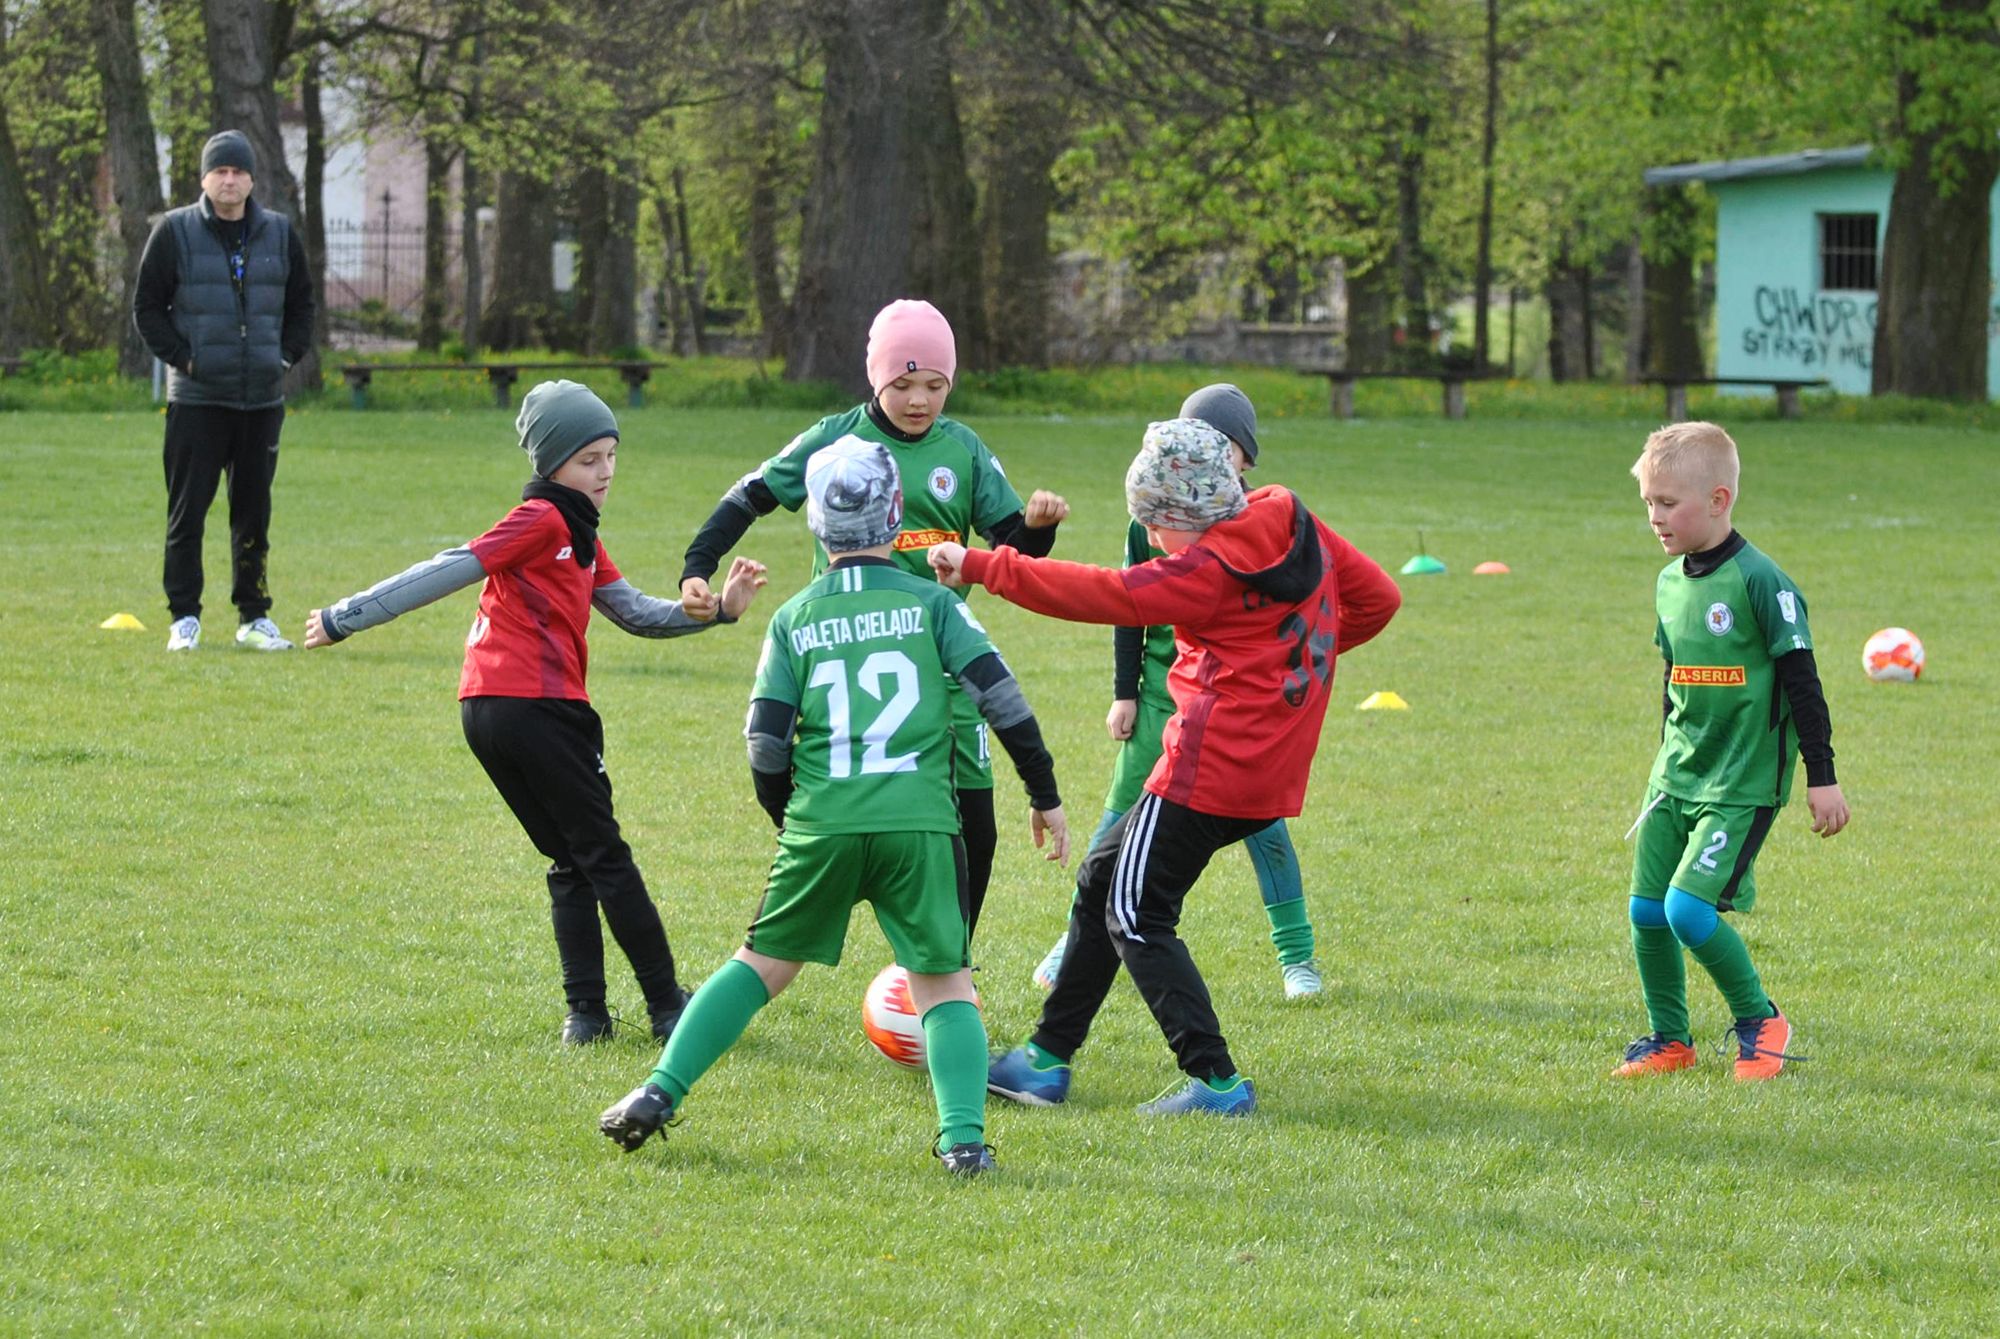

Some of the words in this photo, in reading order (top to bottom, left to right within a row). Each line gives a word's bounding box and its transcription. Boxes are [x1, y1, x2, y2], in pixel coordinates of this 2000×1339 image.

[791, 617, 853, 656] ORLĘTA
[855, 606, 924, 642] CIELĄDZ
[808, 650, 920, 778] 12
[1698, 830, 1728, 869] 2
